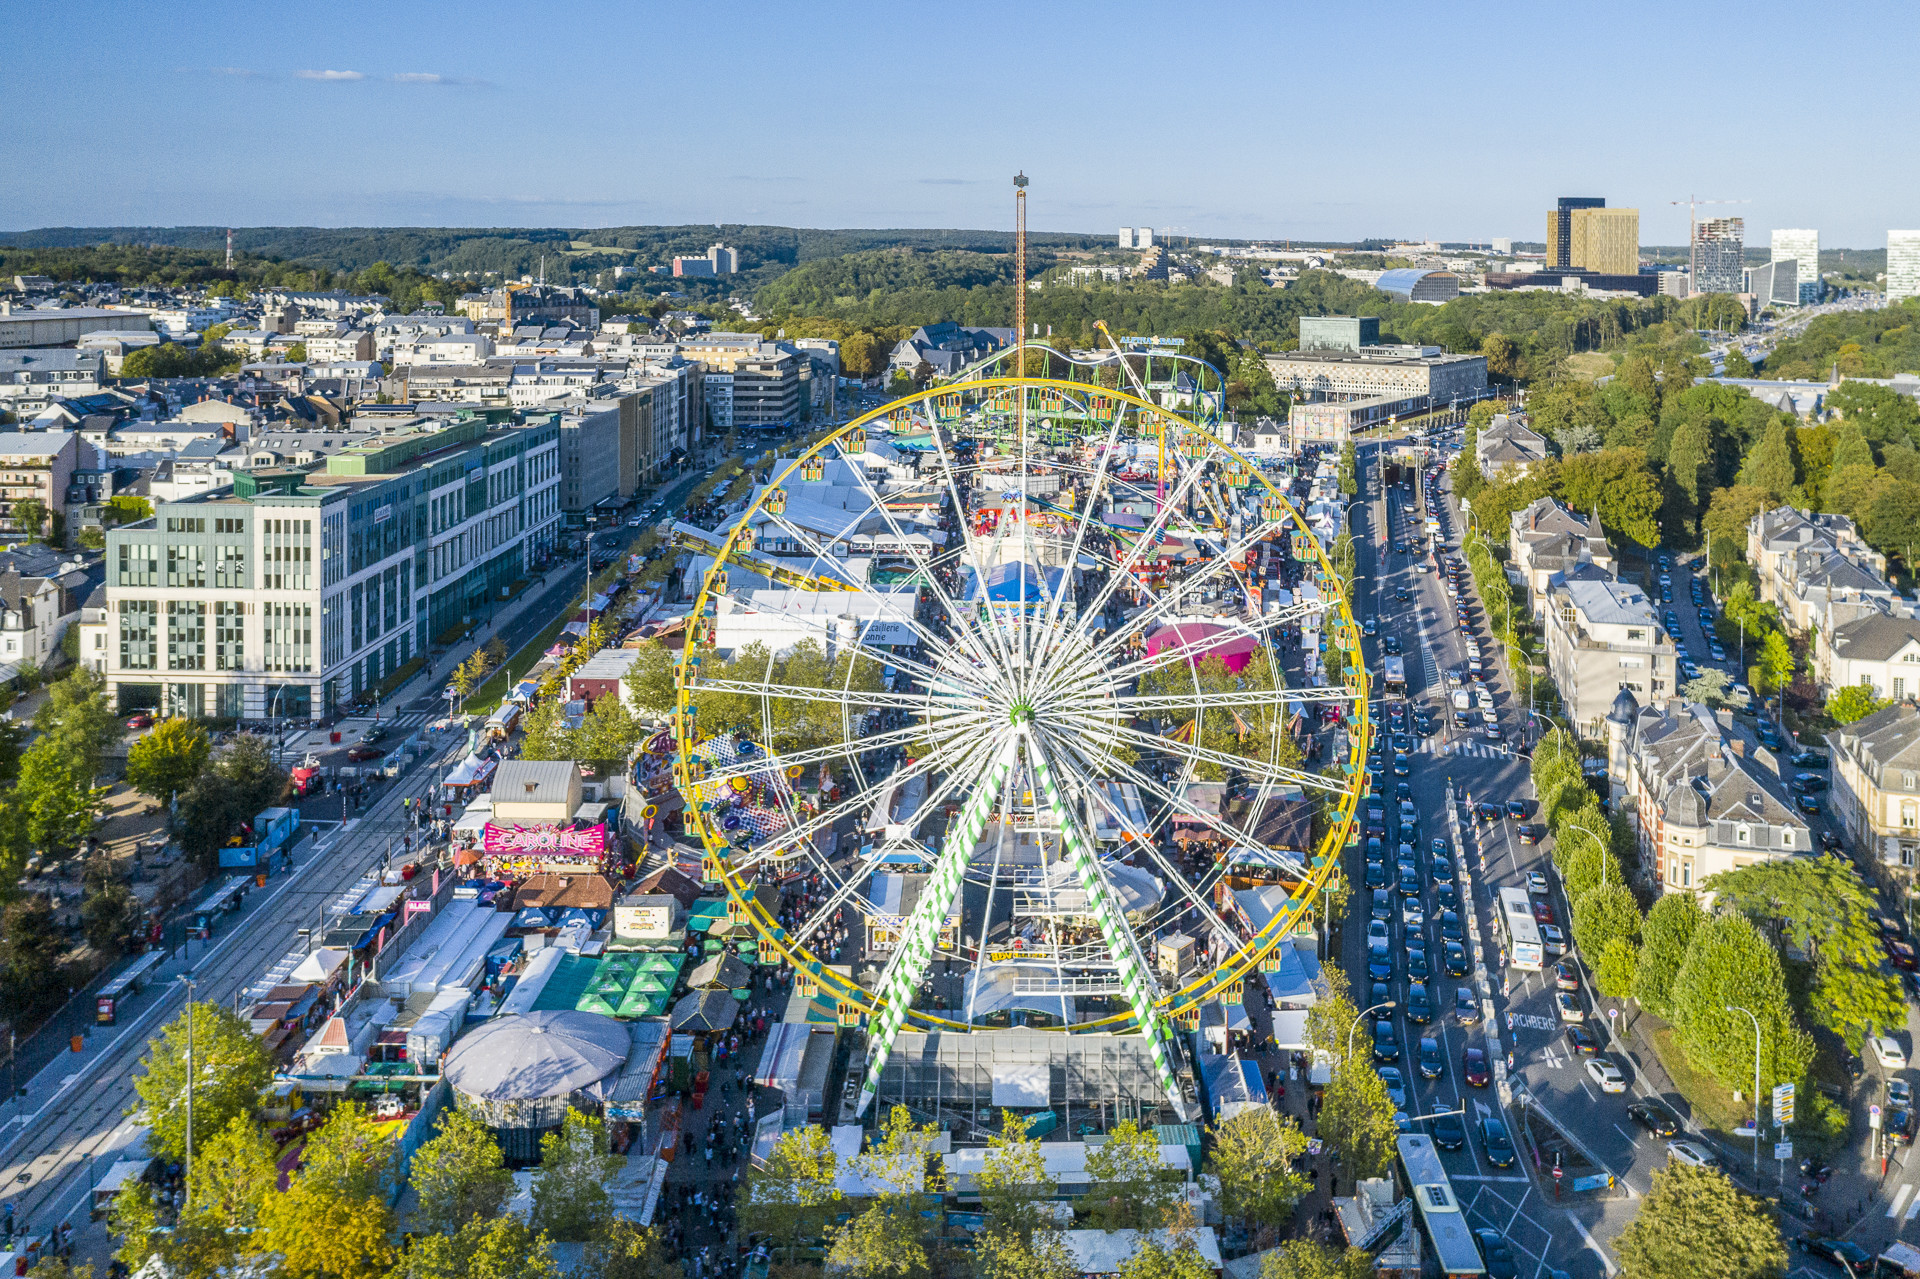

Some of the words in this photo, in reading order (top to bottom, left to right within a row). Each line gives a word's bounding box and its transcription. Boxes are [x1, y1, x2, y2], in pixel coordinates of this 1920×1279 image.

[497, 832, 591, 849] CAROLINE
[408, 902, 430, 910] ALACE
[1503, 1011, 1556, 1031] KRCHBERG
